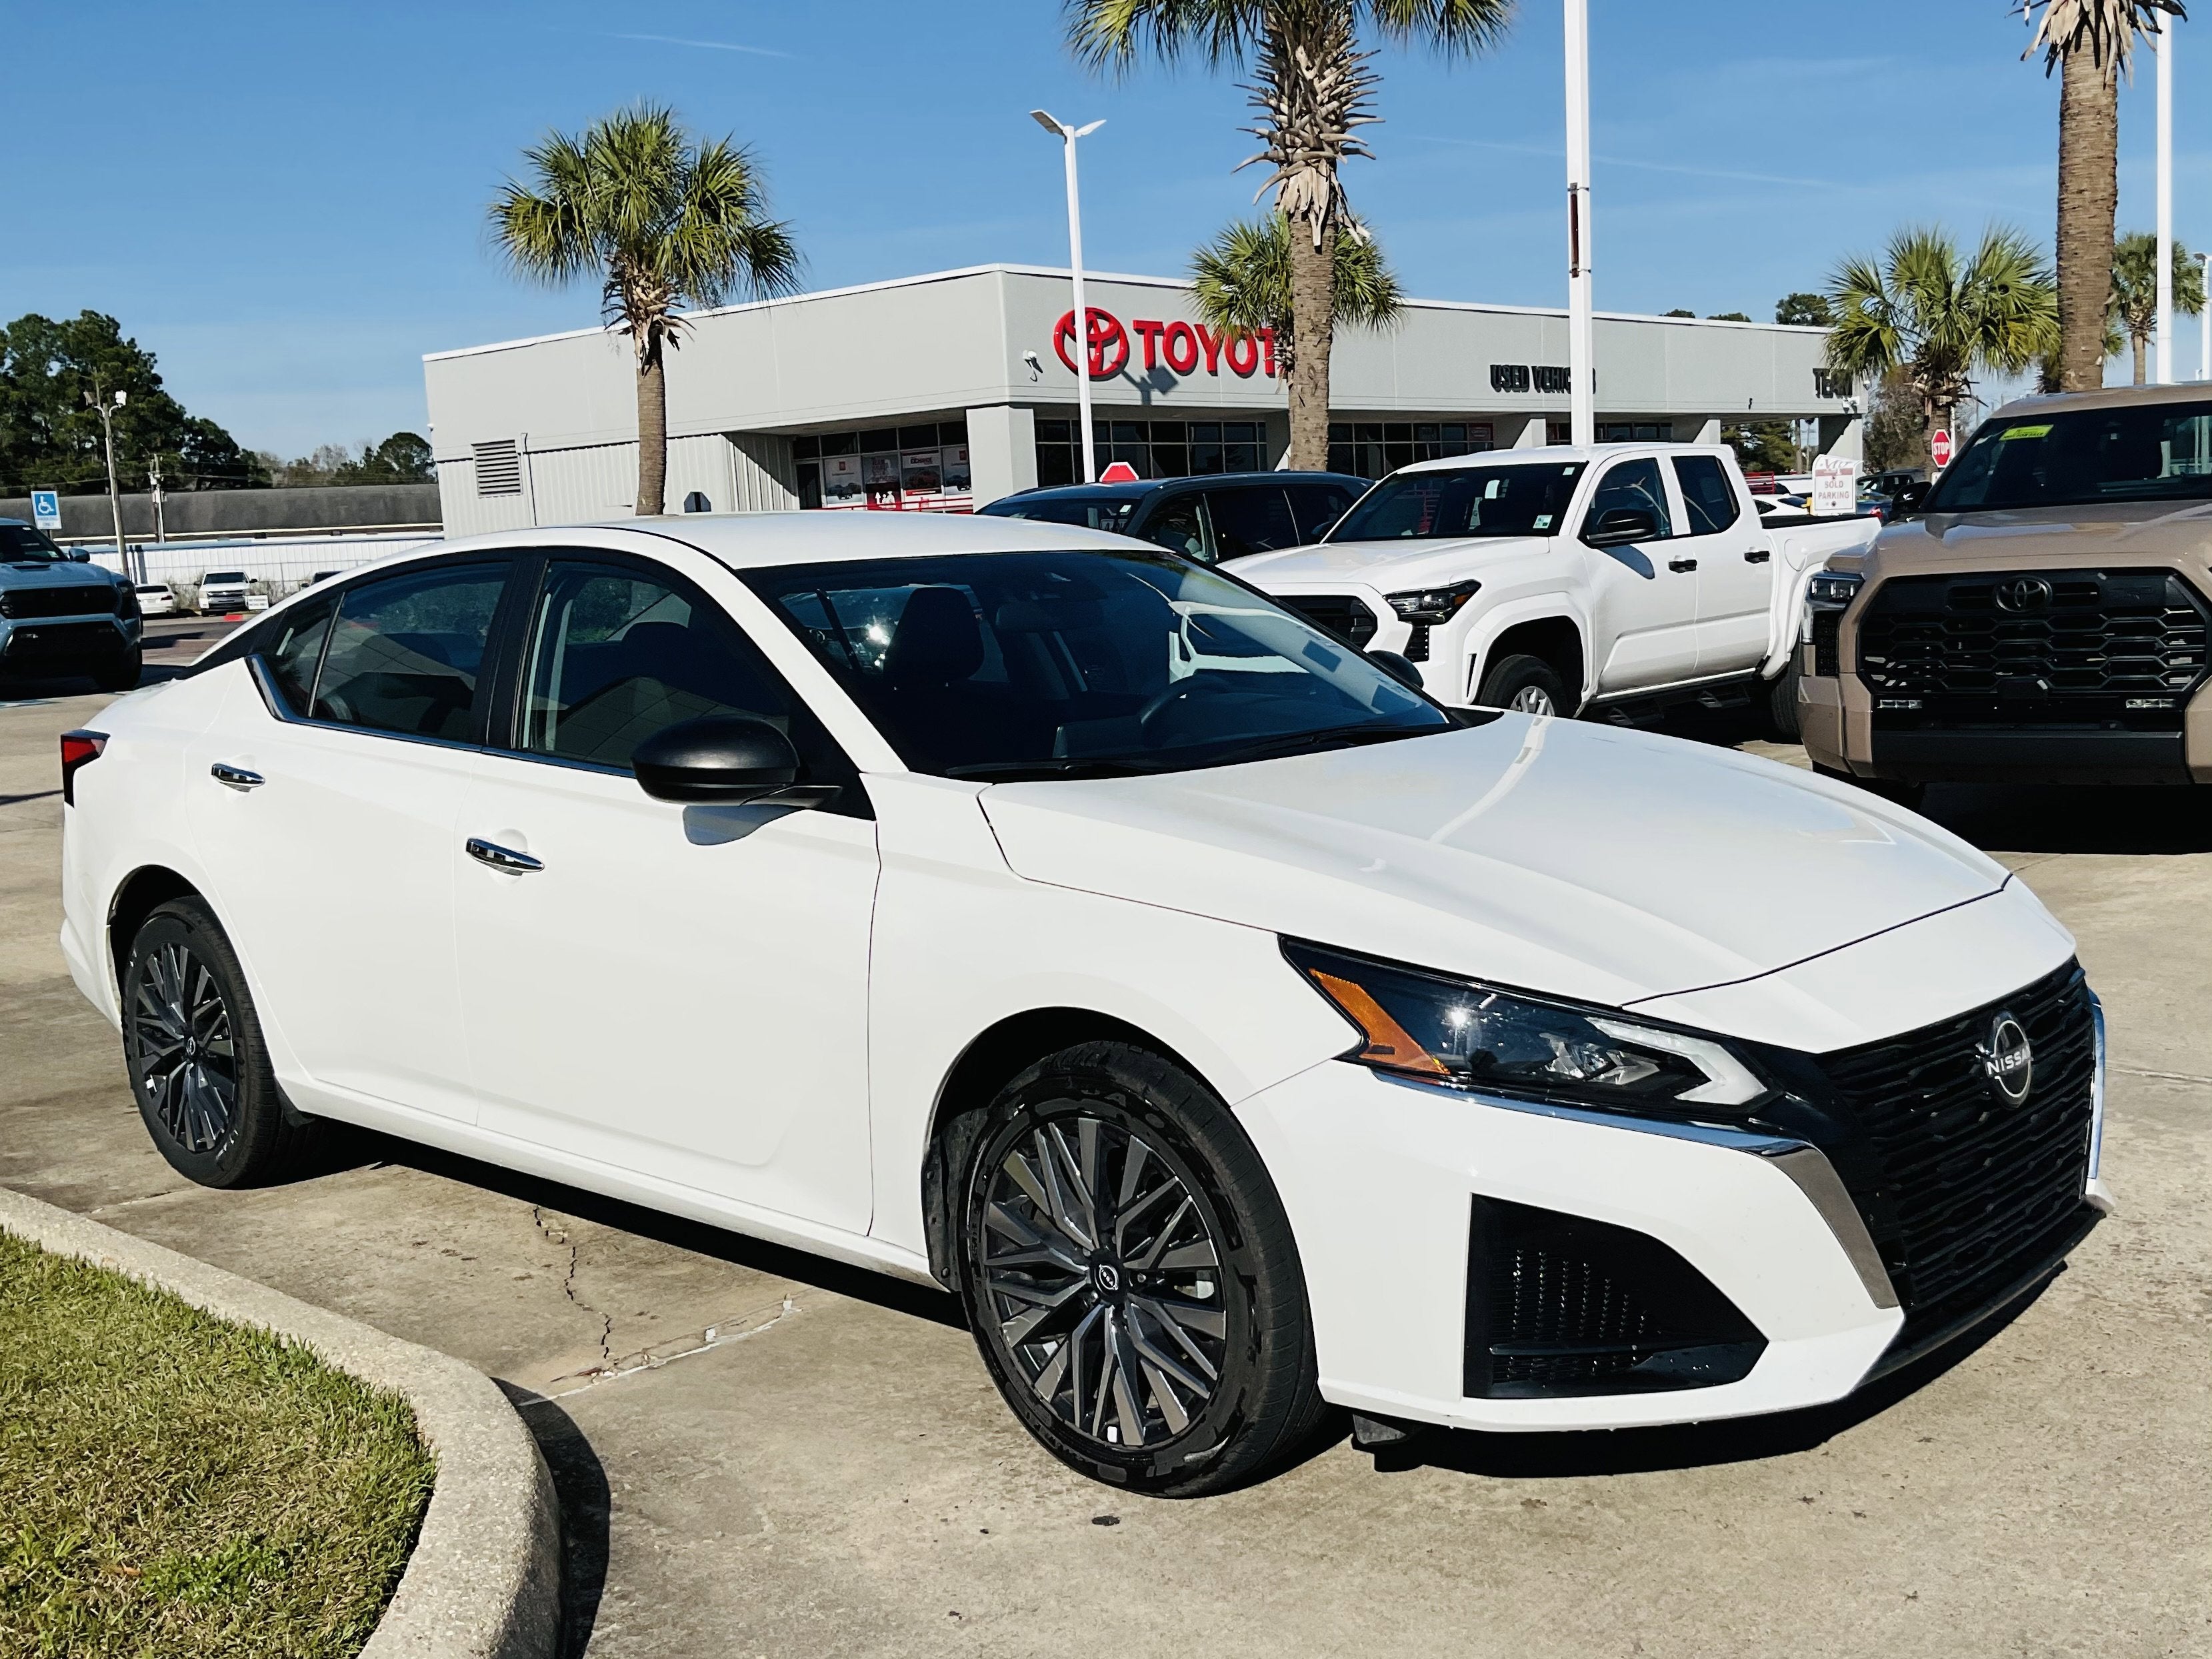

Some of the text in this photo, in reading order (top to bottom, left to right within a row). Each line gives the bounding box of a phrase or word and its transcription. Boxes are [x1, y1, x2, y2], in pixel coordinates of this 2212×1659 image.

[1133, 320, 1276, 377] TOYOT
[1490, 364, 1596, 394] USED VEHIC
[1933, 442, 1949, 455] STOP
[1825, 480, 1843, 488] SOLD
[1818, 491, 1849, 499] PARKING
[1986, 1046, 2031, 1076] NISSA
